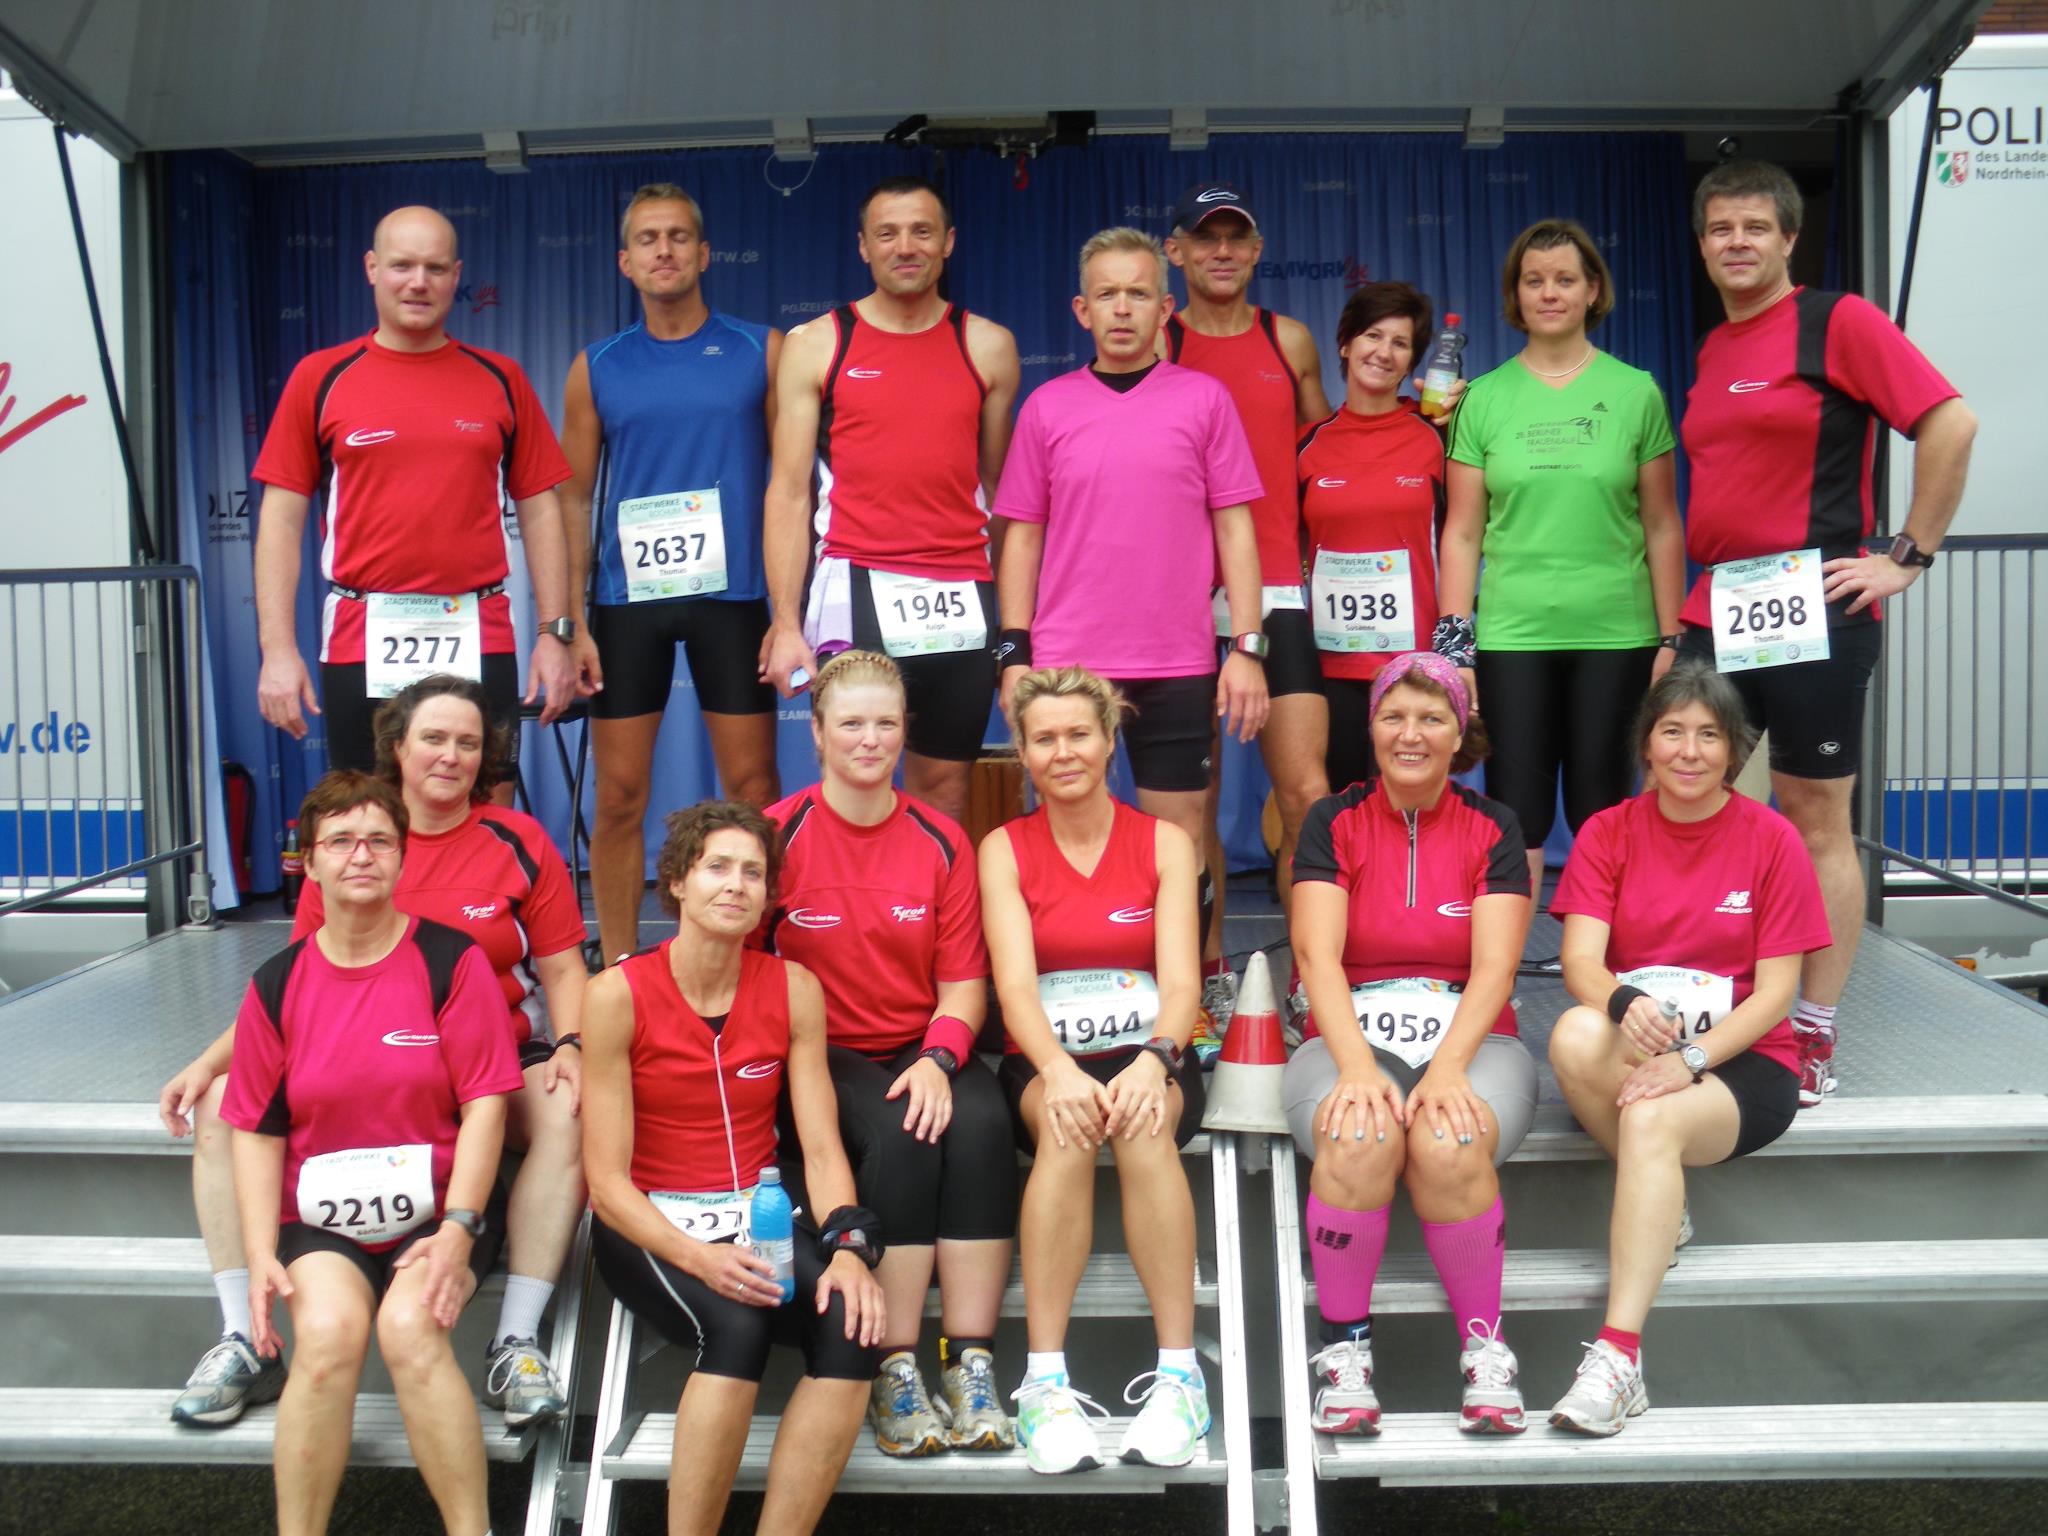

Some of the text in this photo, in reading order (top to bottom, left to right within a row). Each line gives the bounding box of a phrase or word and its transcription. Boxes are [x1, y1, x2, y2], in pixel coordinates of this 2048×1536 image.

[1936, 106, 2043, 145] POLI
[1975, 151, 2048, 162] des Lande
[634, 532, 706, 568] 2637
[893, 591, 966, 623] 1945
[1326, 593, 1397, 621] 1938
[1728, 595, 1807, 635] 2698
[383, 636, 461, 664] 2277
[1050, 972, 1113, 986] STADTWERKE
[1053, 1010, 1143, 1044] 1944
[1359, 1012, 1441, 1042] 1958
[318, 1194, 415, 1227] 2219
